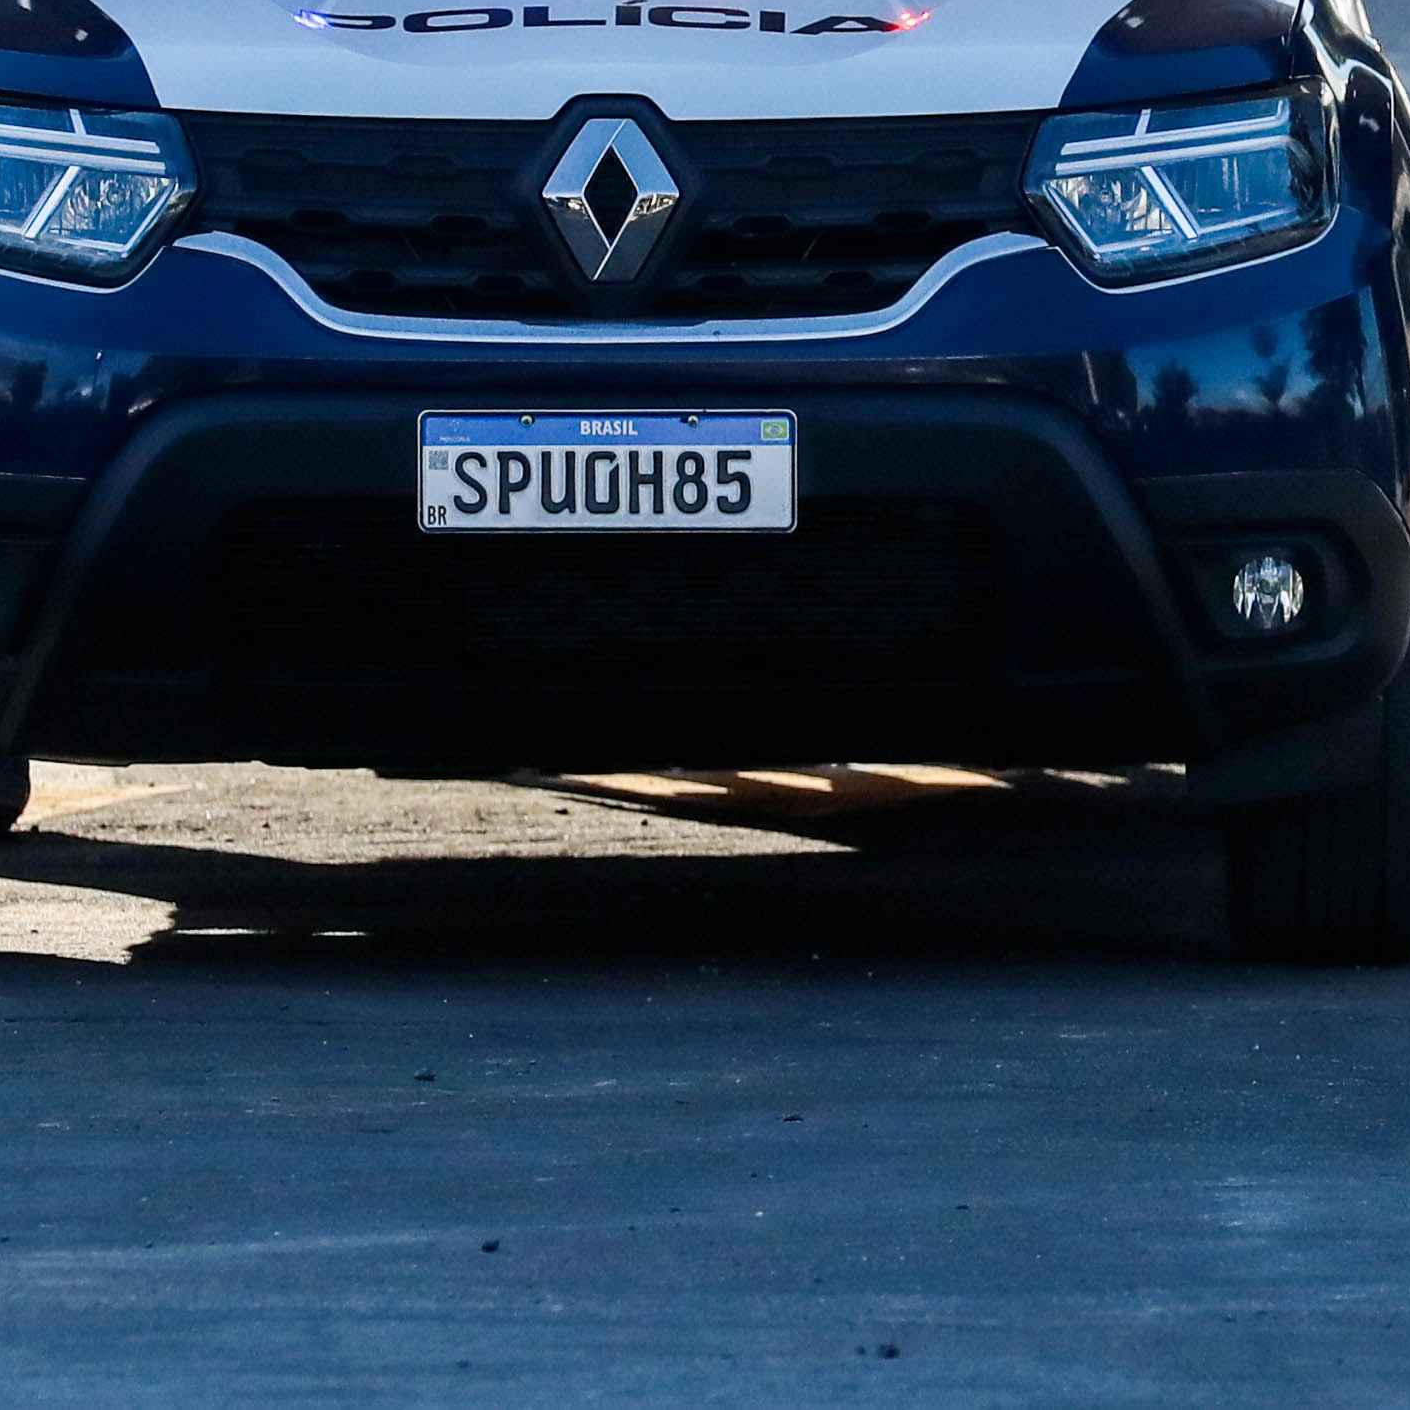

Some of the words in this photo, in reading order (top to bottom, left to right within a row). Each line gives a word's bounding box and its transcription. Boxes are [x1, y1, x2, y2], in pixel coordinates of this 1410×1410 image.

[580, 420, 638, 436] BRASIL
[453, 450, 752, 514] SPU0H85
[427, 505, 447, 526] BR
